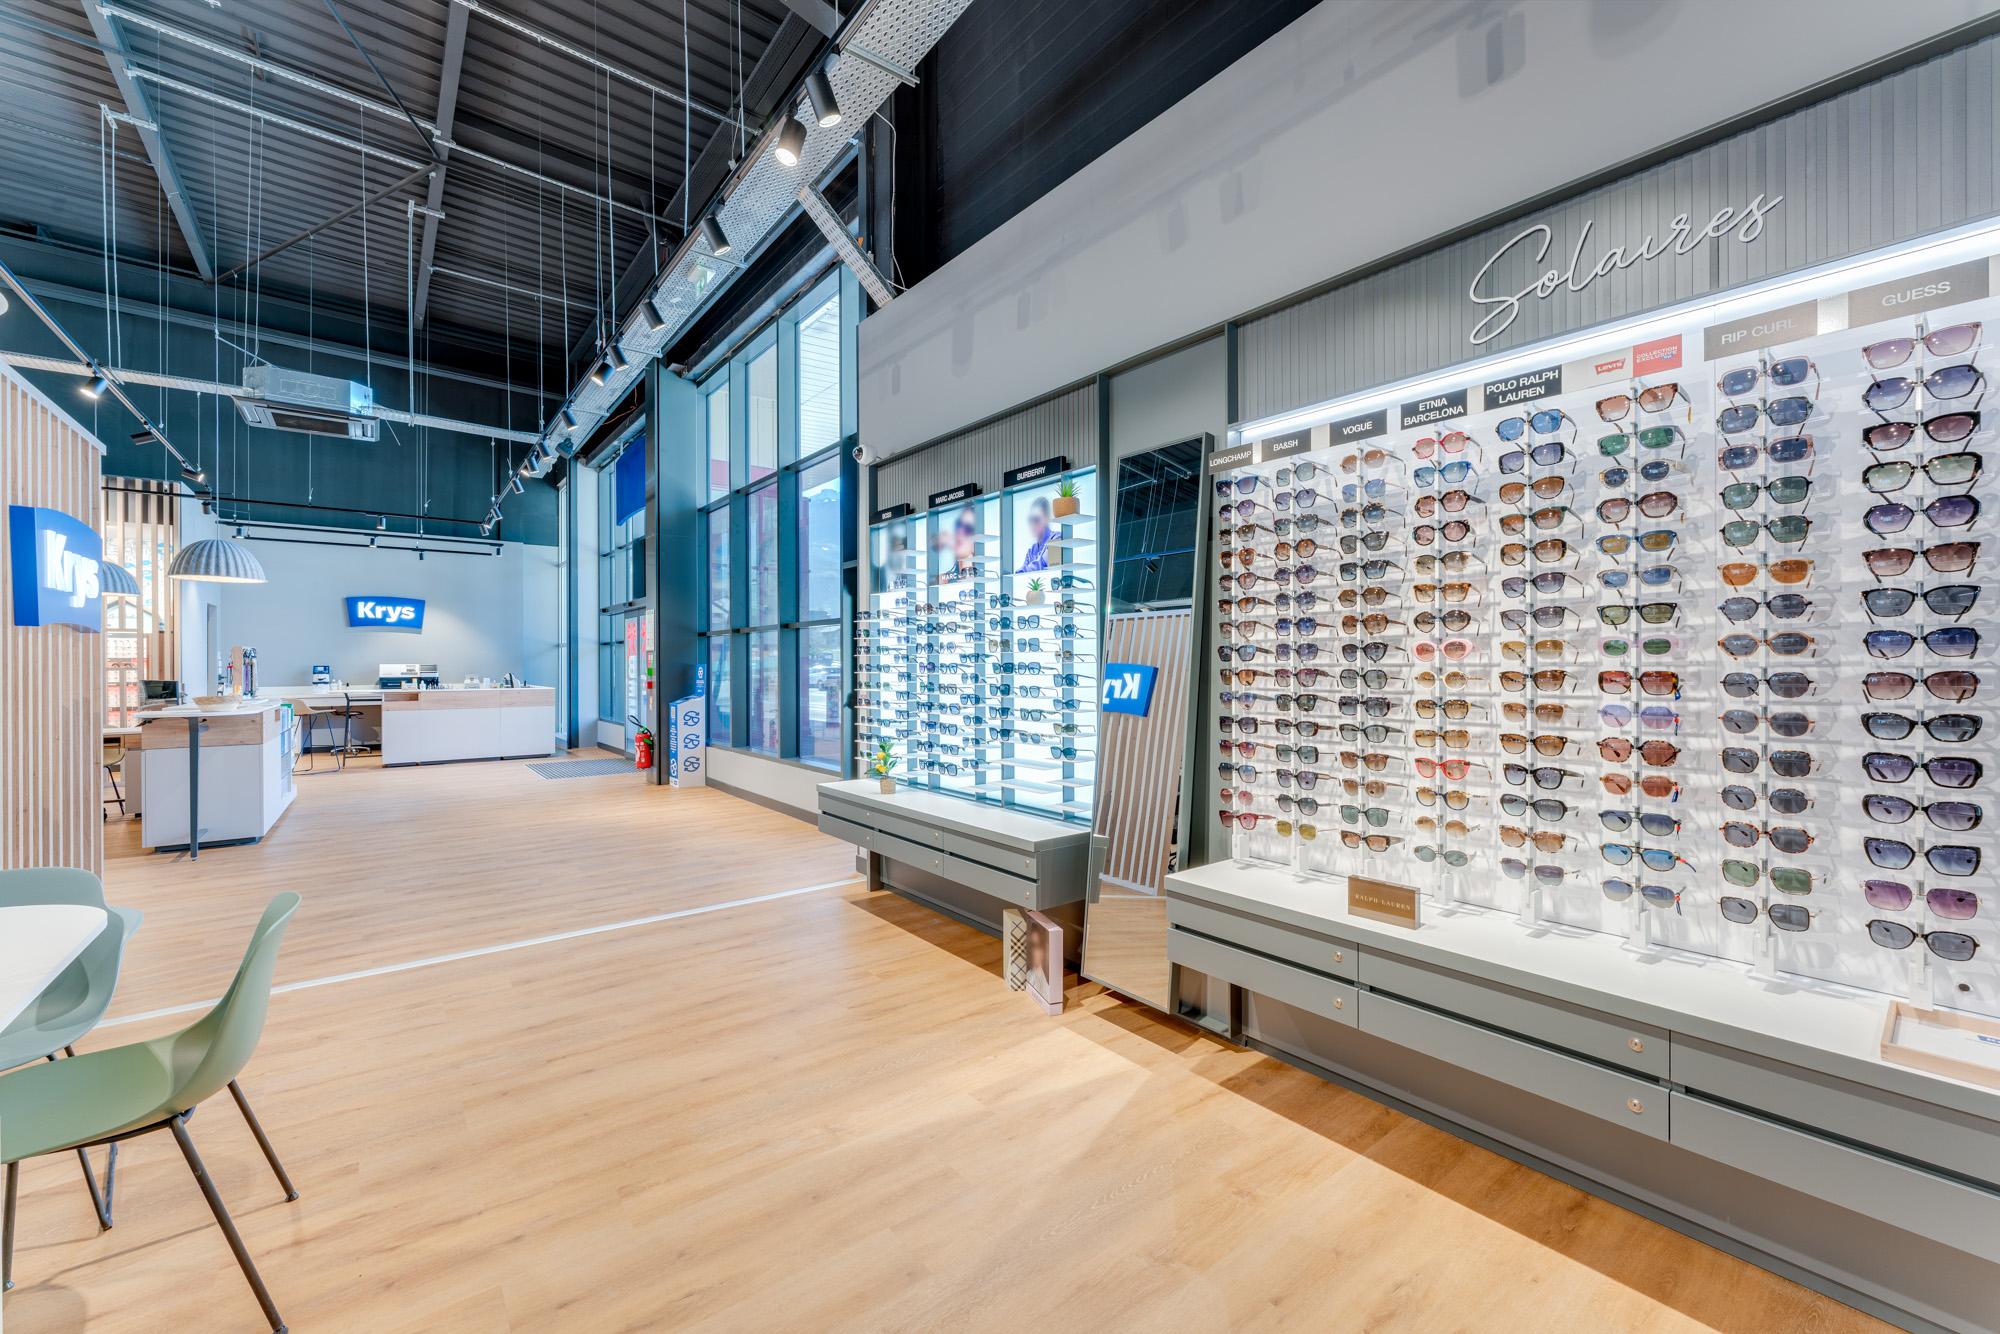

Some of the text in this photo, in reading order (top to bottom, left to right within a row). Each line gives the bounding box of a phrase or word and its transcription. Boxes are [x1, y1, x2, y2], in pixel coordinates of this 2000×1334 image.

[1469, 193, 1784, 345] Solaires
[1882, 280, 1951, 307] GUESS
[1721, 318, 1798, 345] RIP CURL
[1636, 345, 1678, 359] COLLECTION
[1636, 351, 1677, 364] EXCLUSIVE
[1486, 370, 1559, 396] POLO RALPH
[1498, 385, 1545, 404] LAUREN
[1418, 398, 1448, 412] ETNIA
[1403, 405, 1464, 427] BARCELONA
[1342, 421, 1373, 436] VOGUE
[1273, 439, 1298, 452] BA&SH
[1209, 450, 1252, 467] LONGCHAMP
[1017, 466, 1046, 481] BURBERRY
[935, 495, 948, 504] MARC
[42, 529, 100, 609] Krys
[357, 601, 415, 622] Krys
[1355, 893, 1411, 911] RALPH LAUREN
